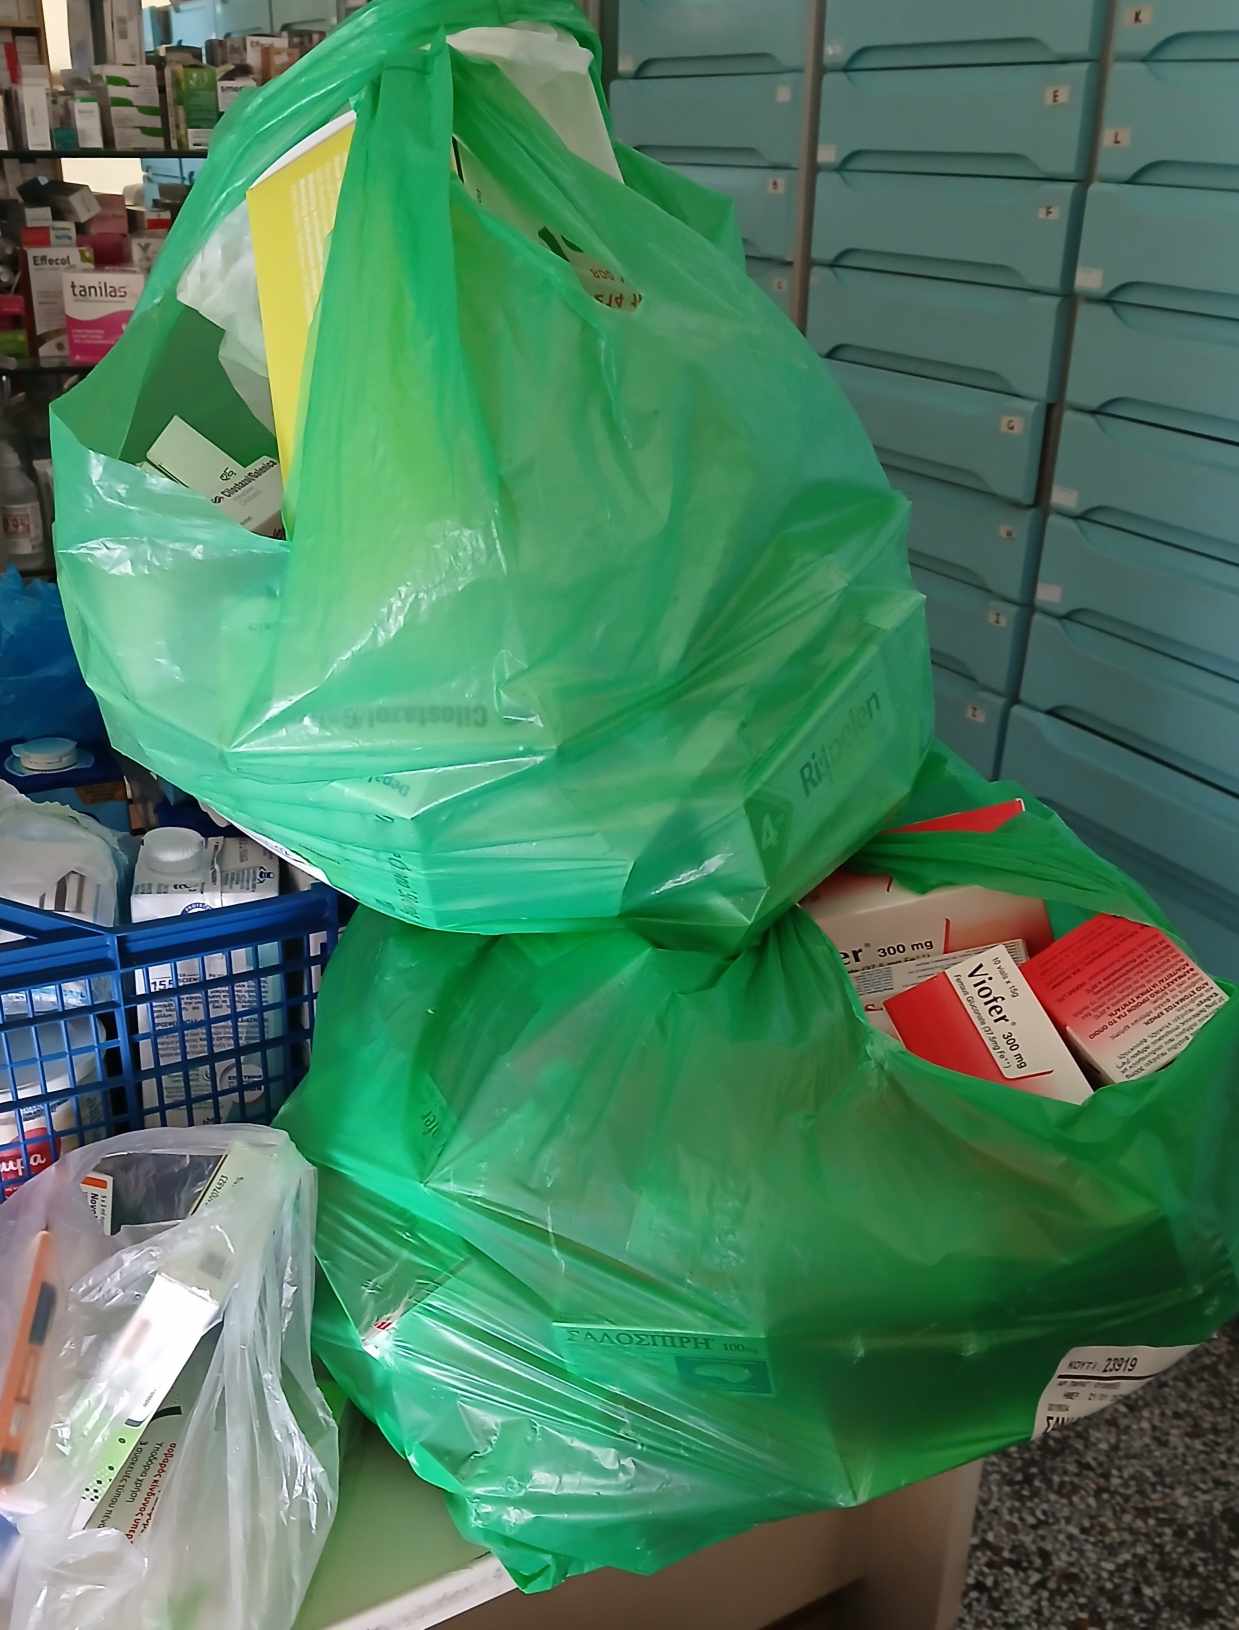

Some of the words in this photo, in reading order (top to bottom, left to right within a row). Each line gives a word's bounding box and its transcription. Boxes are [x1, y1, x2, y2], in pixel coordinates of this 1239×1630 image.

[1134, 10, 1142, 24] K
[1052, 89, 1059, 103] E
[1113, 131, 1120, 144] L
[32, 254, 72, 268] Effecol
[70, 279, 128, 298] tanilas
[878, 943, 906, 959] 300
[911, 939, 934, 952] mg
[1002, 1031, 1020, 1051] 300
[1014, 1053, 1028, 1069] mg
[1102, 1357, 1138, 1373] 23919
